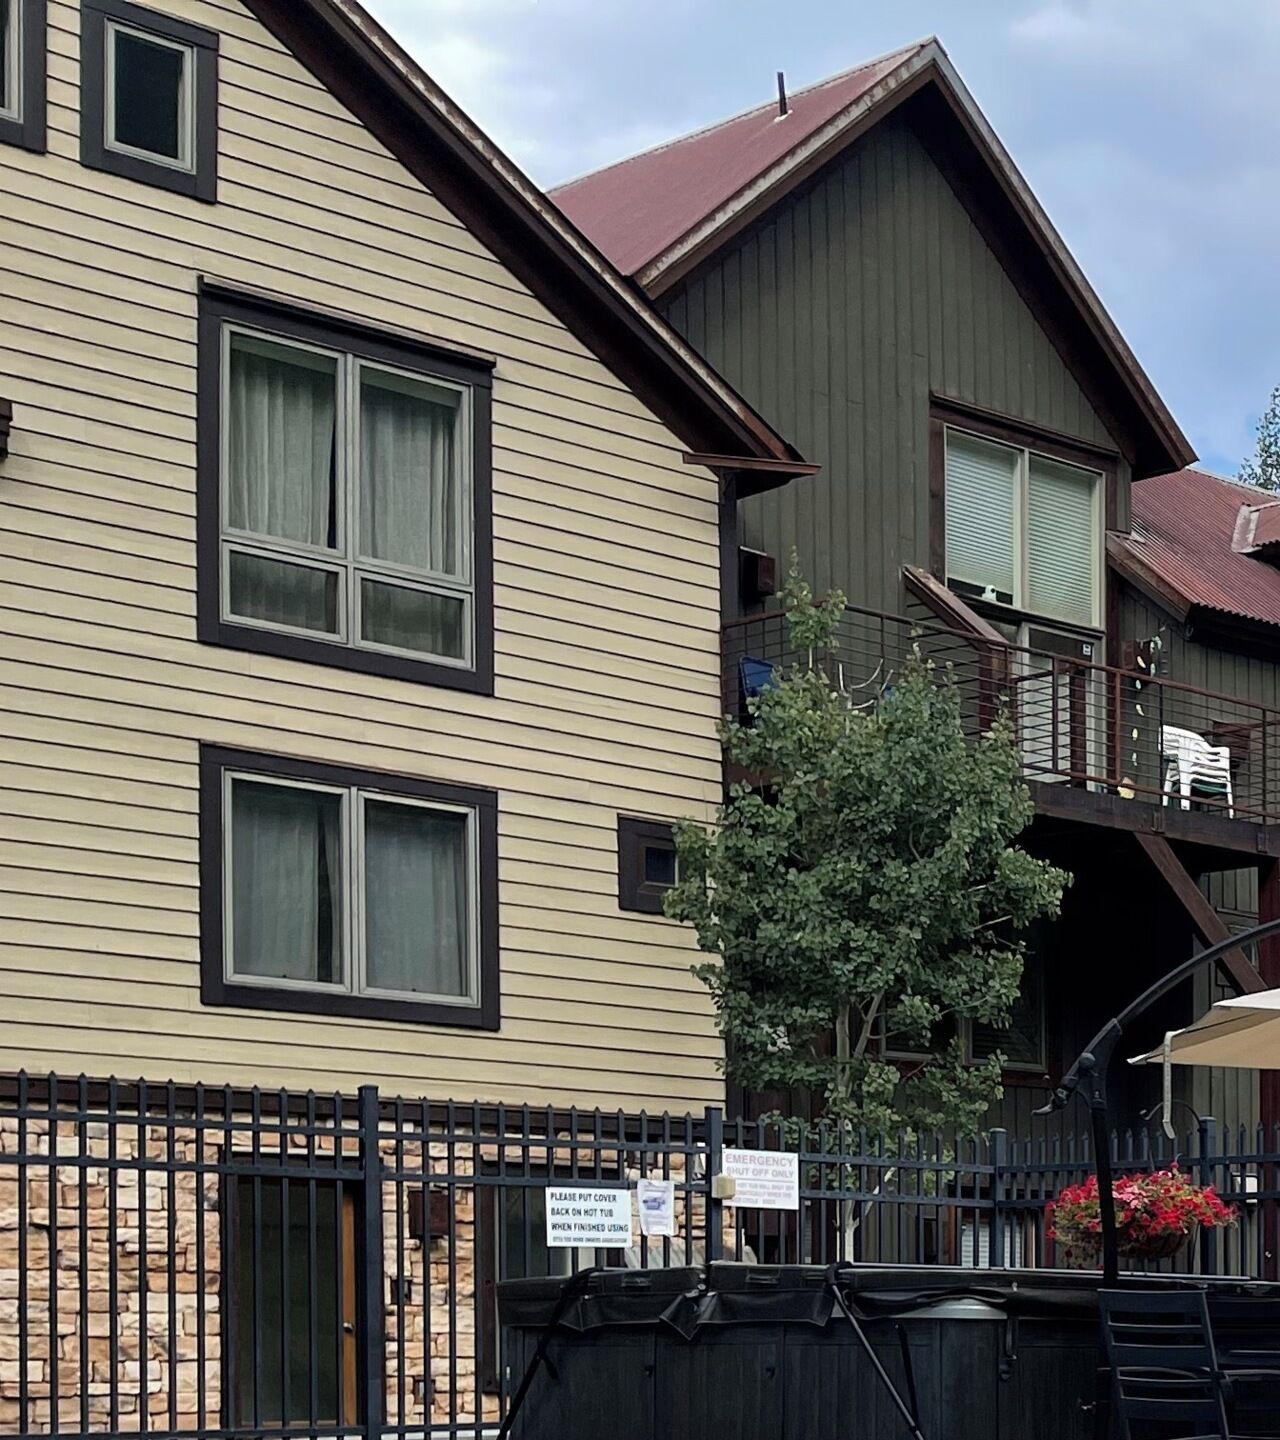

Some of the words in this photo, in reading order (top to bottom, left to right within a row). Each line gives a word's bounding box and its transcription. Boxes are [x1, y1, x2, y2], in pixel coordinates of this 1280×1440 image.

[725, 1153, 794, 1167] EMERGENCY
[726, 1166, 751, 1176] SHUT
[752, 1168, 770, 1177] OFF
[771, 1169, 794, 1178] ONLY
[550, 1192, 576, 1202] PLEASE
[578, 1193, 592, 1202] PUT
[594, 1194, 617, 1203] COVER
[550, 1207, 570, 1216] BACK
[572, 1208, 582, 1217] ON
[583, 1208, 597, 1217] HOT
[599, 1208, 614, 1217] TUB
[551, 1223, 572, 1231] WHEN
[573, 1223, 606, 1232] FINISHED
[607, 1224, 629, 1233] USING
